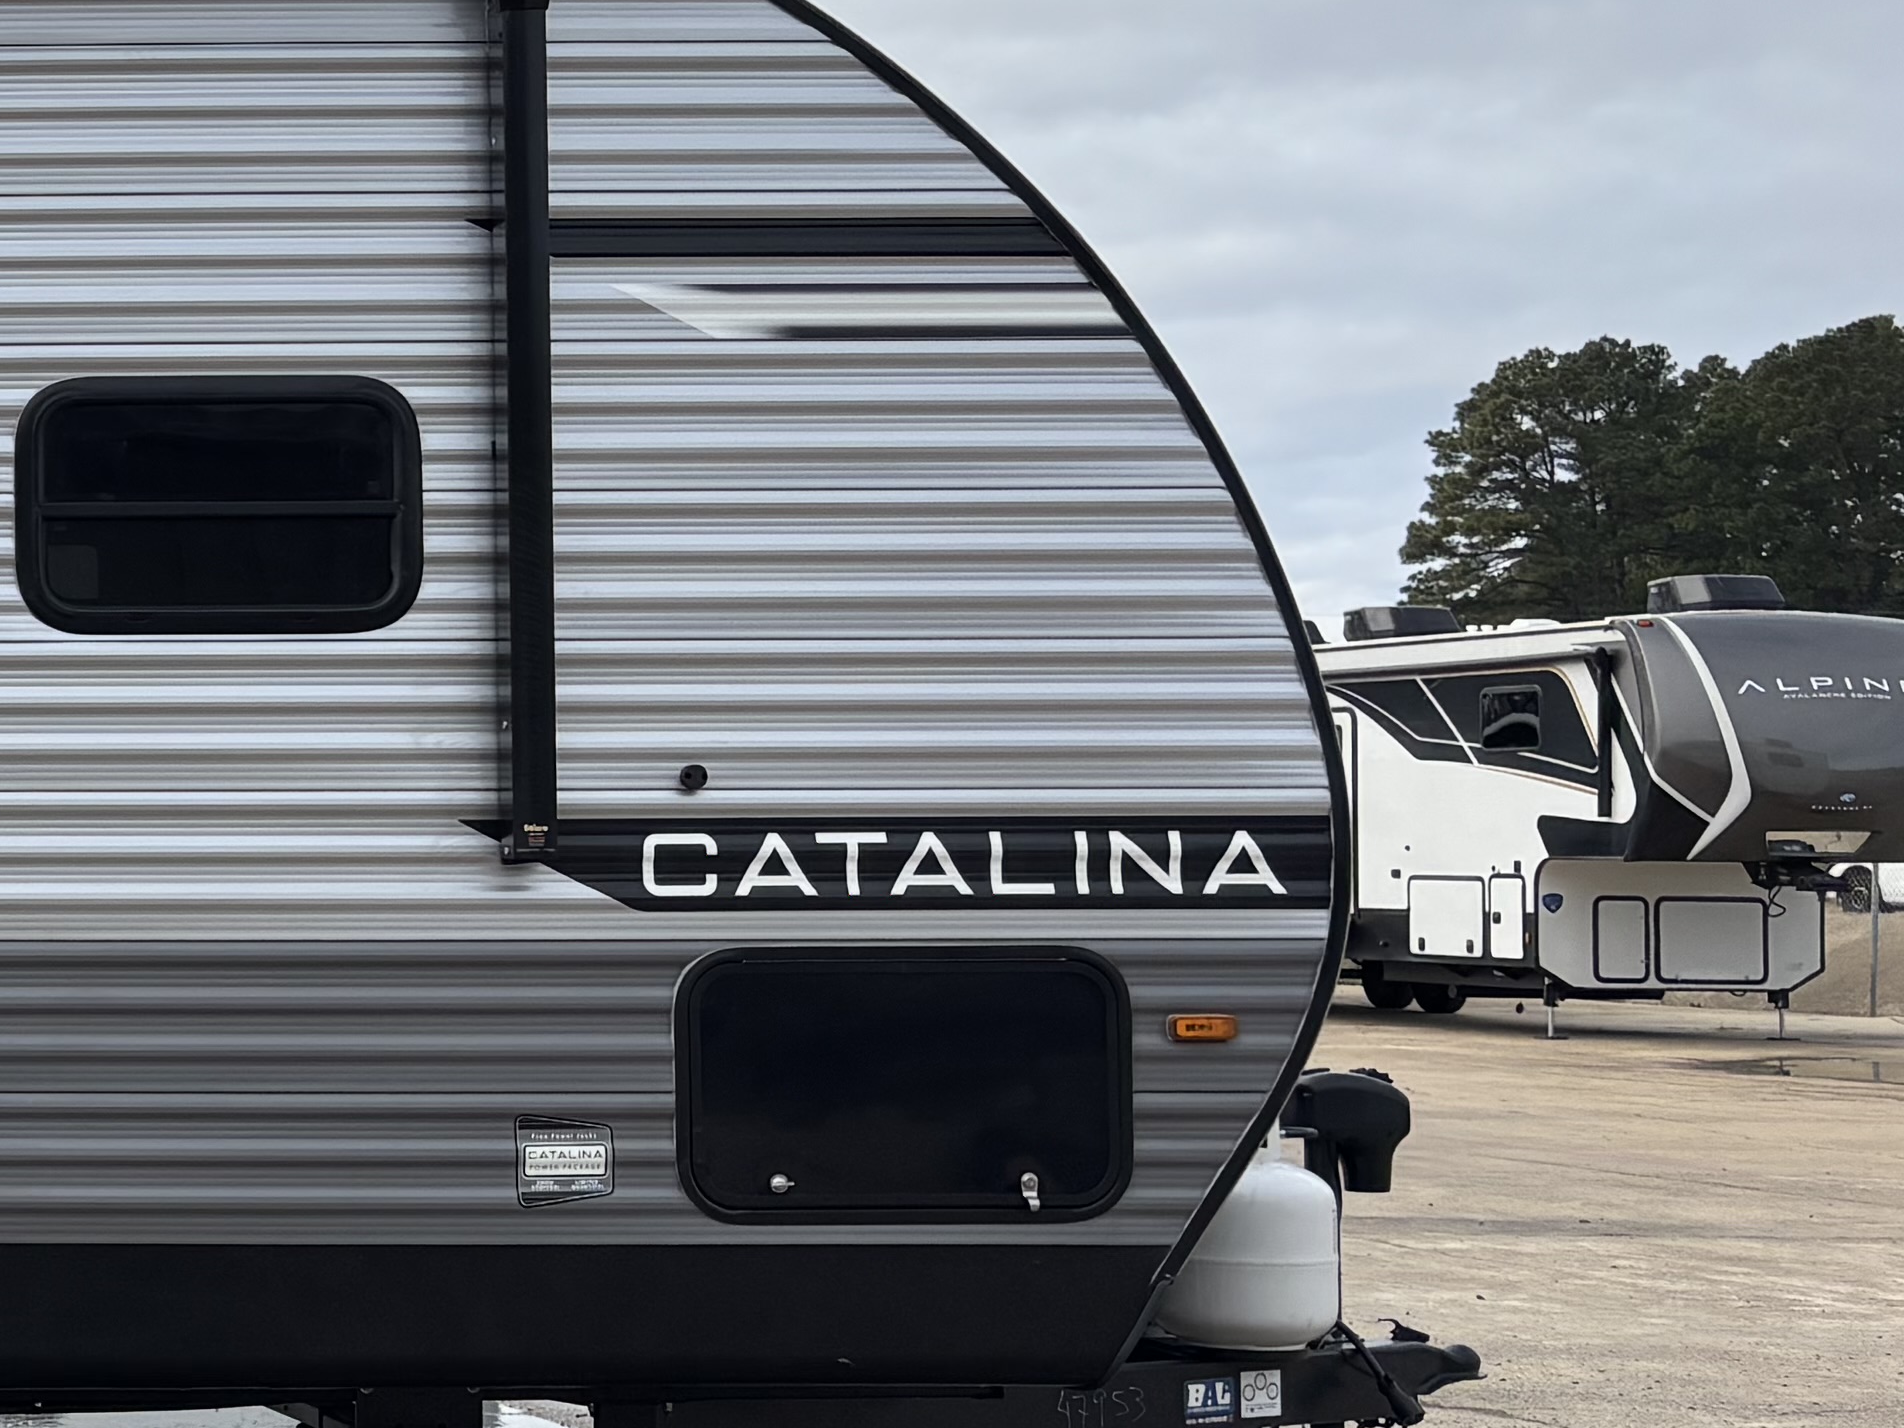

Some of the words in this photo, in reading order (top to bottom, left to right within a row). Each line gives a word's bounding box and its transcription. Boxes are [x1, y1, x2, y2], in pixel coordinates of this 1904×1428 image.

[1737, 677, 1904, 695] ALPIN
[641, 829, 1288, 897] CATALINA
[528, 1149, 603, 1160] CATALINA
